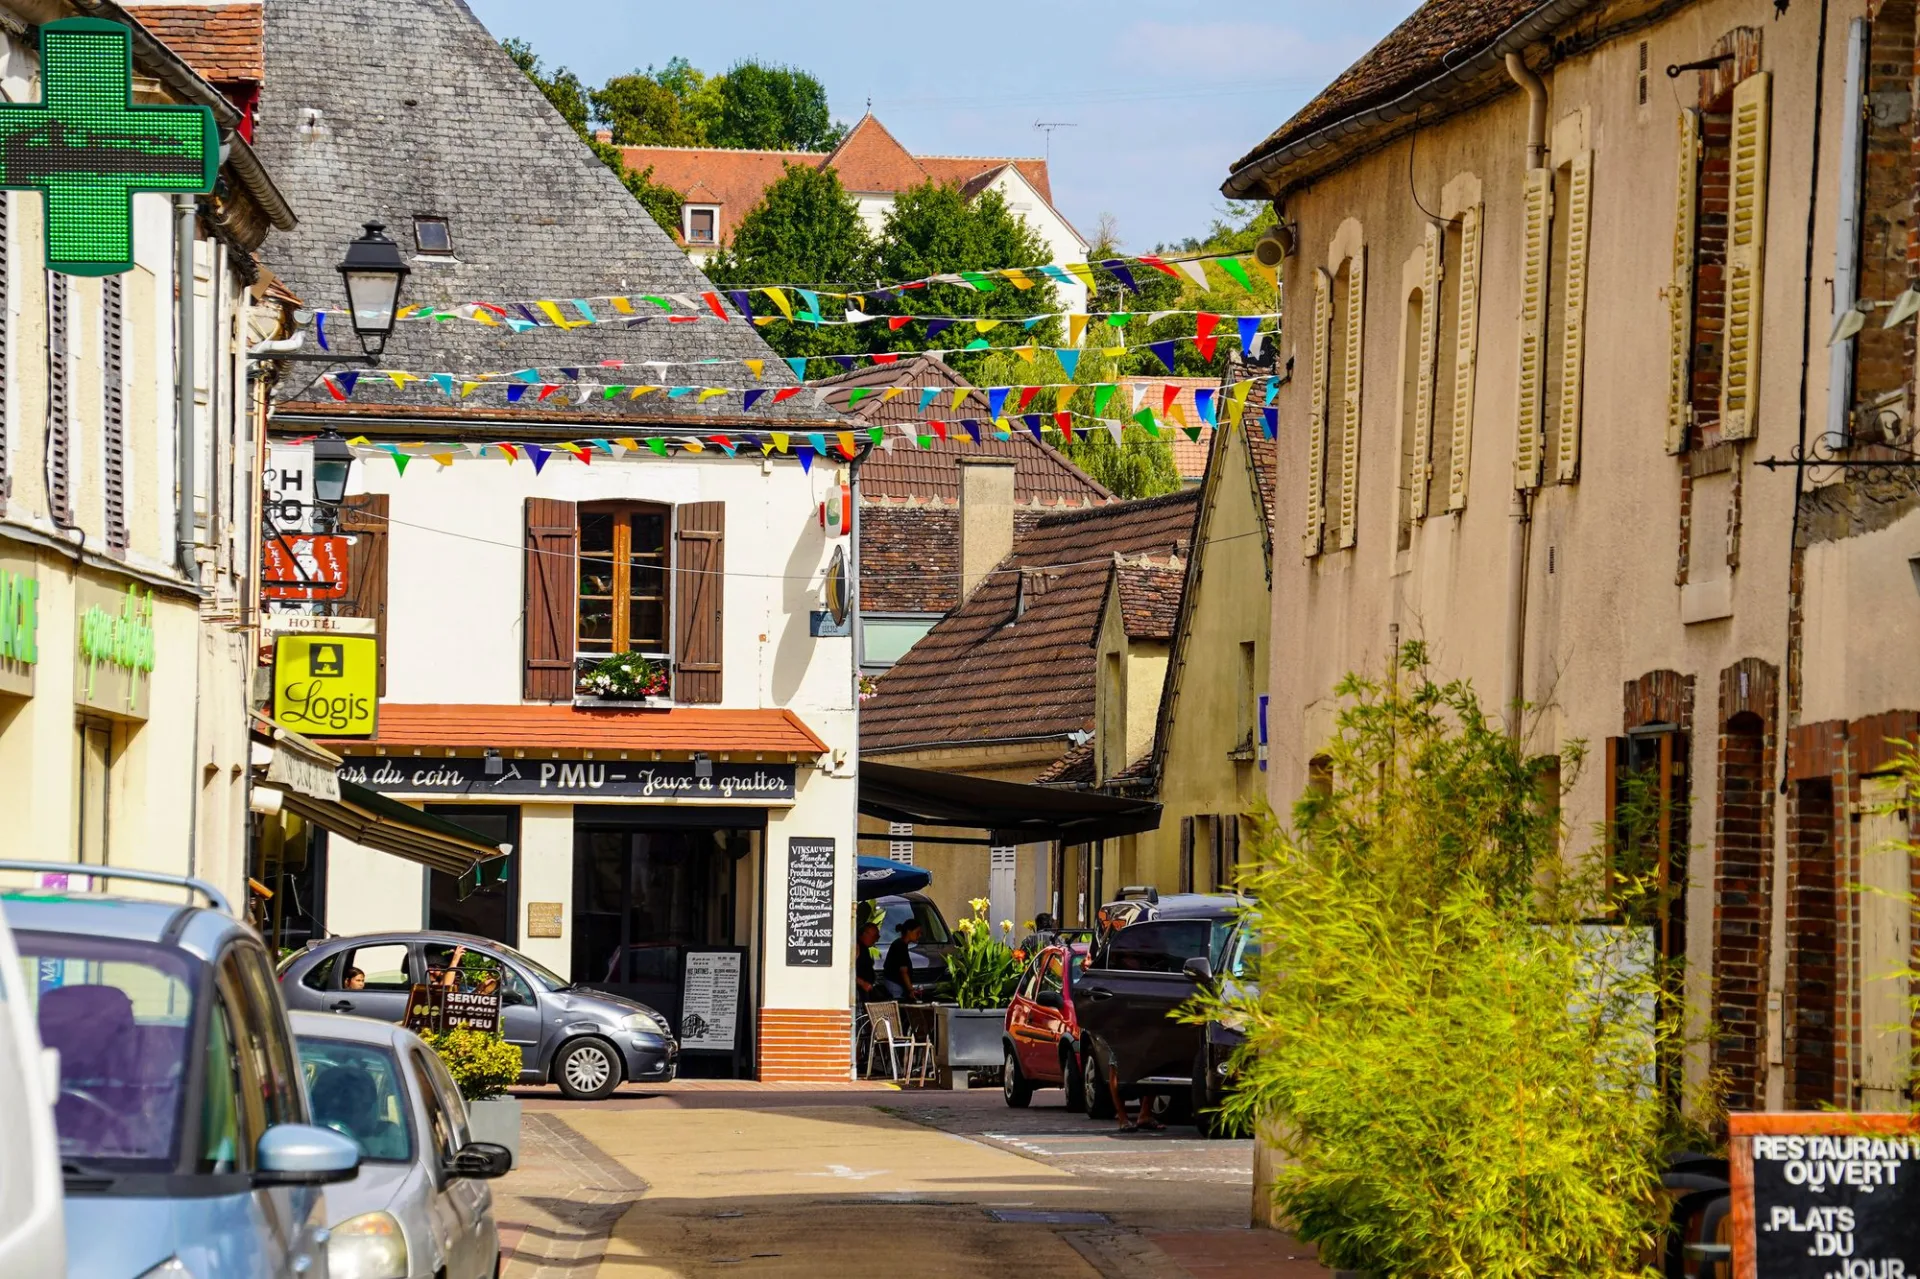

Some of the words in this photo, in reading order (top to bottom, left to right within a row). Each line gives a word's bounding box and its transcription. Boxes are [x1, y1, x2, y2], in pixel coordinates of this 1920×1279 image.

[324, 542, 344, 591] BLANC
[289, 618, 341, 630] HOTEL
[280, 679, 369, 730] Logis
[336, 763, 367, 784] ars
[372, 760, 405, 785] du
[412, 764, 464, 787] coin
[540, 763, 605, 788] PMU
[638, 768, 693, 797] Jeux
[719, 771, 788, 797] gratter
[796, 928, 832, 937] TERRASSE
[447, 993, 498, 1006] SERVICE
[469, 1018, 492, 1029] FEU
[1753, 1135, 1920, 1160] RESTAURANT
[1783, 1160, 1901, 1185] OUVERT
